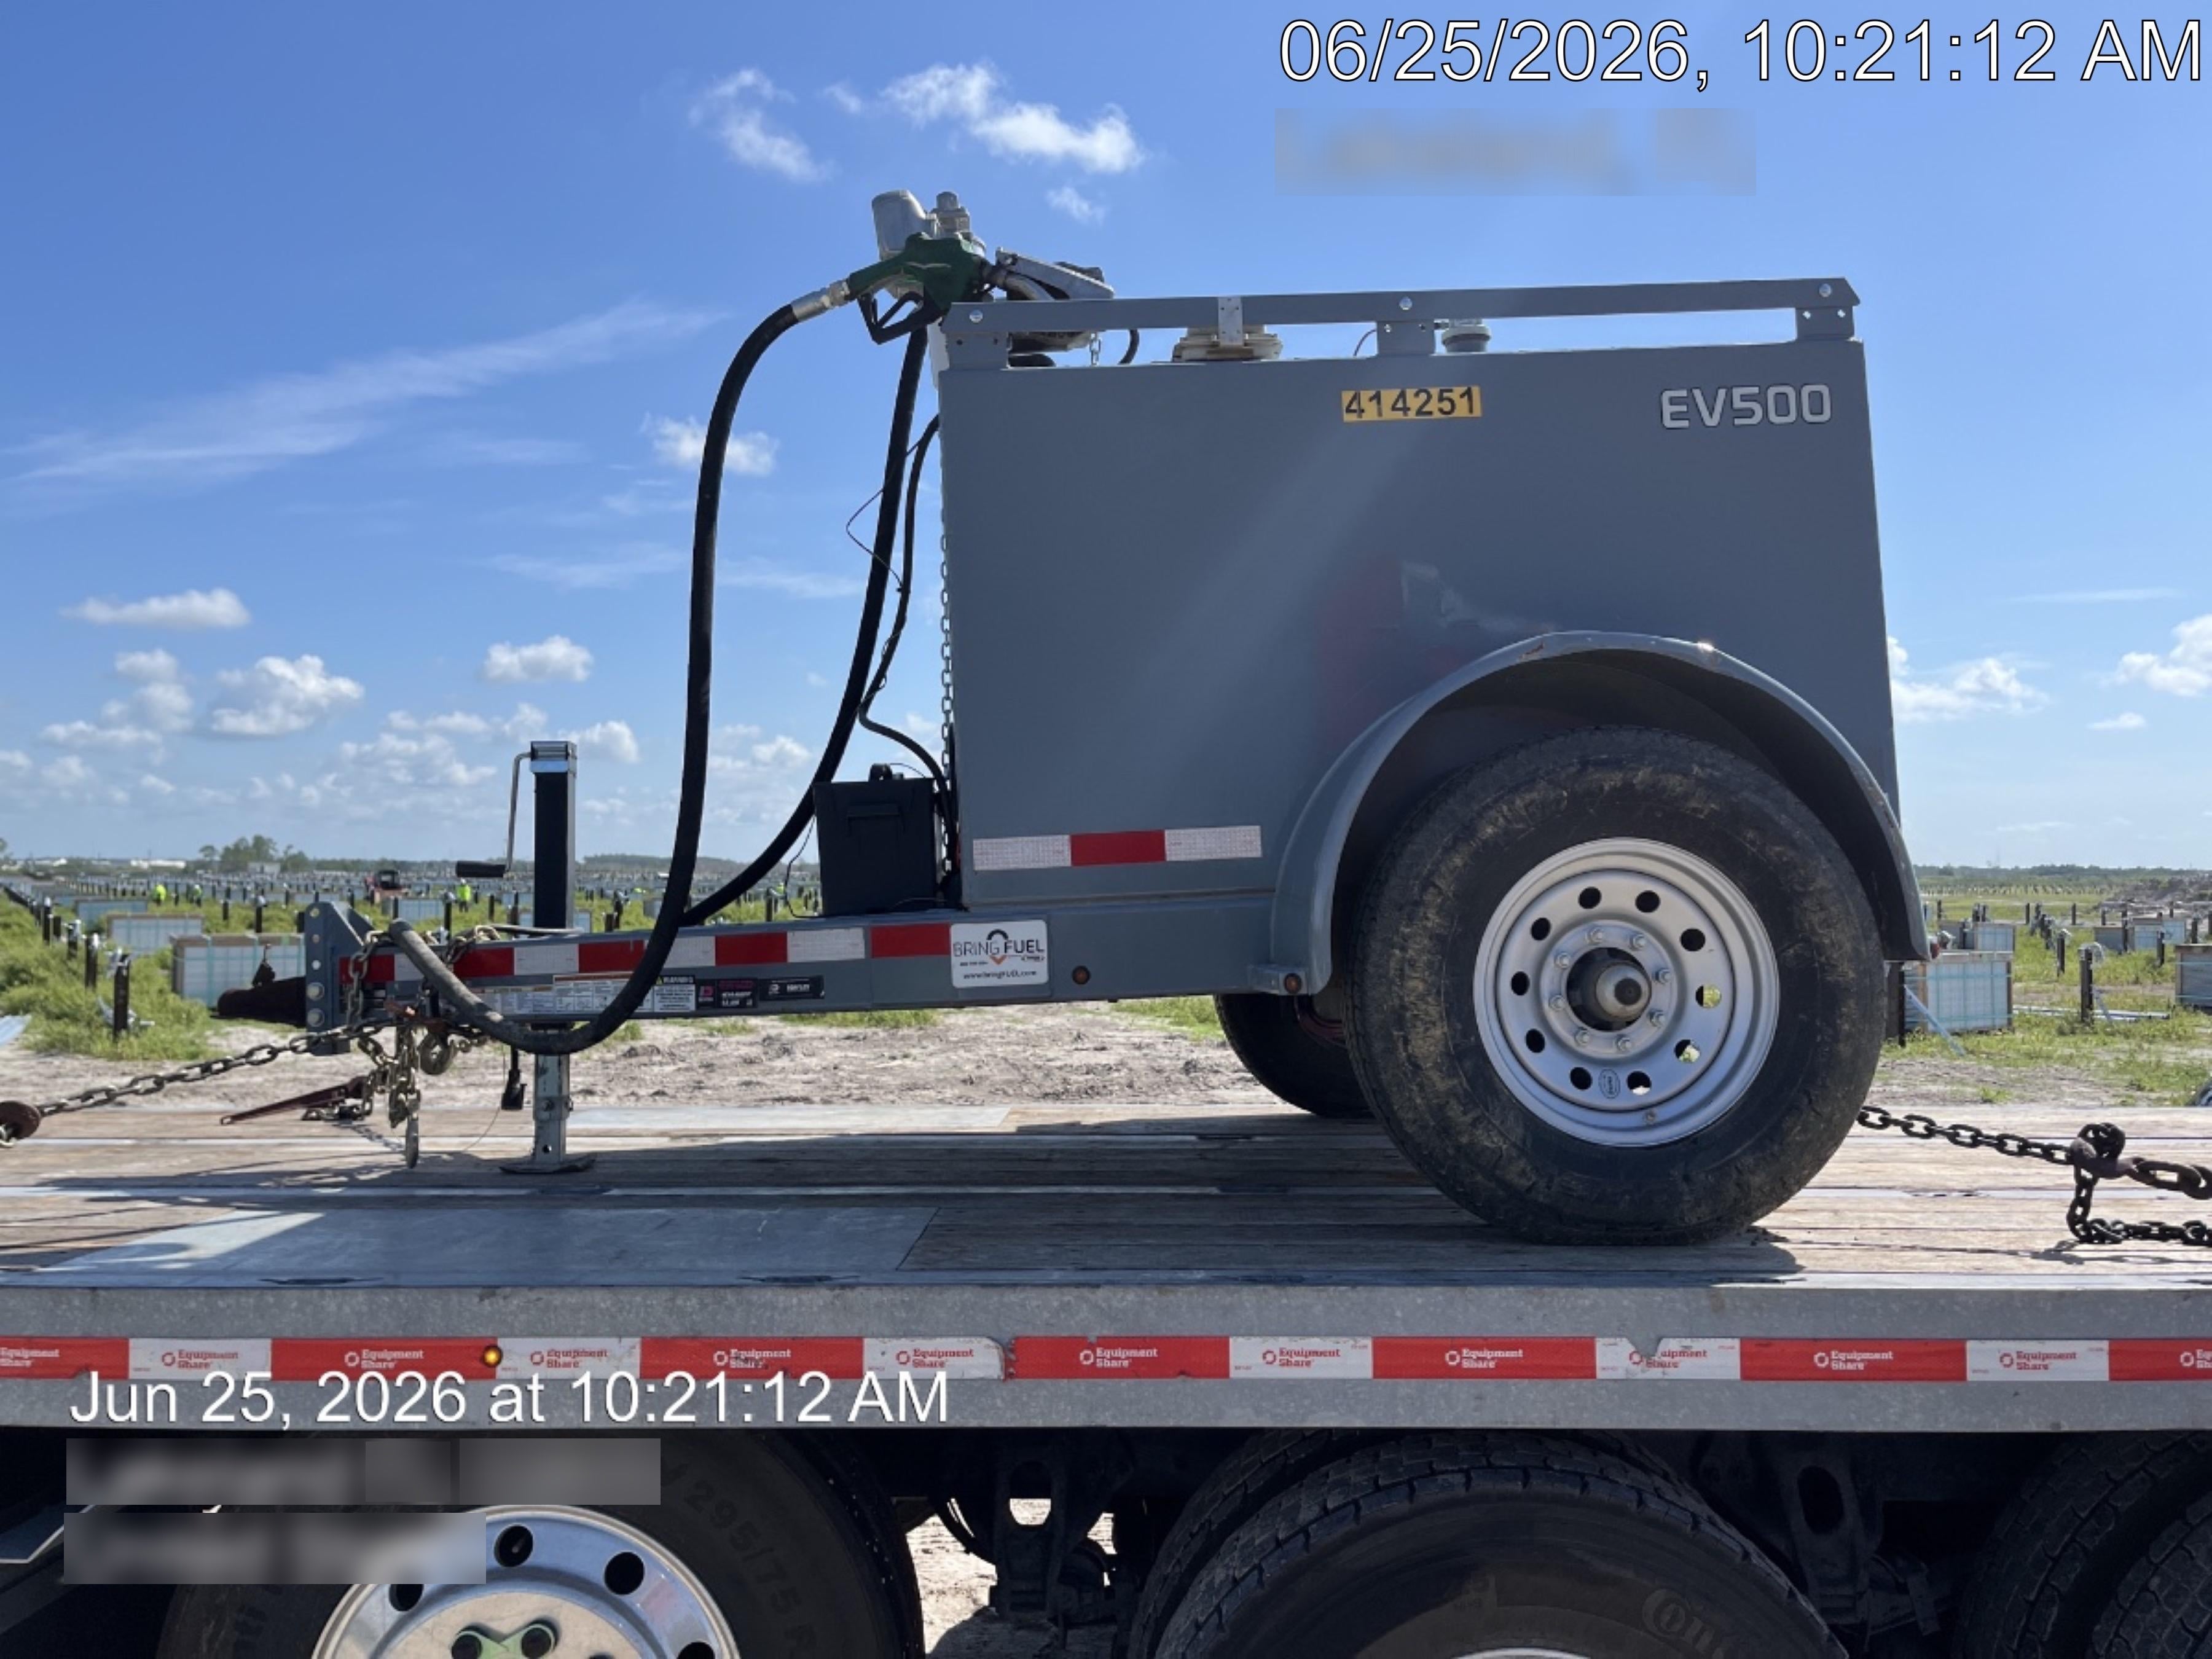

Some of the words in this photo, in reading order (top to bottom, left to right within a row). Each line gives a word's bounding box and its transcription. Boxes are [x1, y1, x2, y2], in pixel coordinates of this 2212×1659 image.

[1344, 386, 1476, 418] 414251
[1660, 384, 1832, 429] EV500
[953, 941, 1000, 957] BRING
[1004, 939, 1045, 953] FUEL
[178, 1350, 238, 1360] Equipment
[359, 1349, 423, 1360] Equipment
[547, 1349, 607, 1359] Equipment
[730, 1349, 791, 1359] Equipment
[913, 1348, 973, 1359] Equipment
[1096, 1347, 1158, 1358] Equipment
[1279, 1347, 1341, 1359] Equipment
[1462, 1348, 1523, 1359] Equipment
[1658, 1349, 1708, 1359] uipment
[1831, 1351, 1894, 1361] Equipment
[2016, 1351, 2077, 1362] Equipment
[178, 1360, 210, 1369] Share
[359, 1359, 394, 1369] Share
[547, 1359, 579, 1368] Share
[912, 1359, 945, 1368] Share
[1096, 1358, 1129, 1368] Share
[1279, 1359, 1311, 1368] Share
[1462, 1358, 1495, 1368] Share
[1831, 1360, 1865, 1370] Share
[2016, 1361, 2050, 1370] Share
